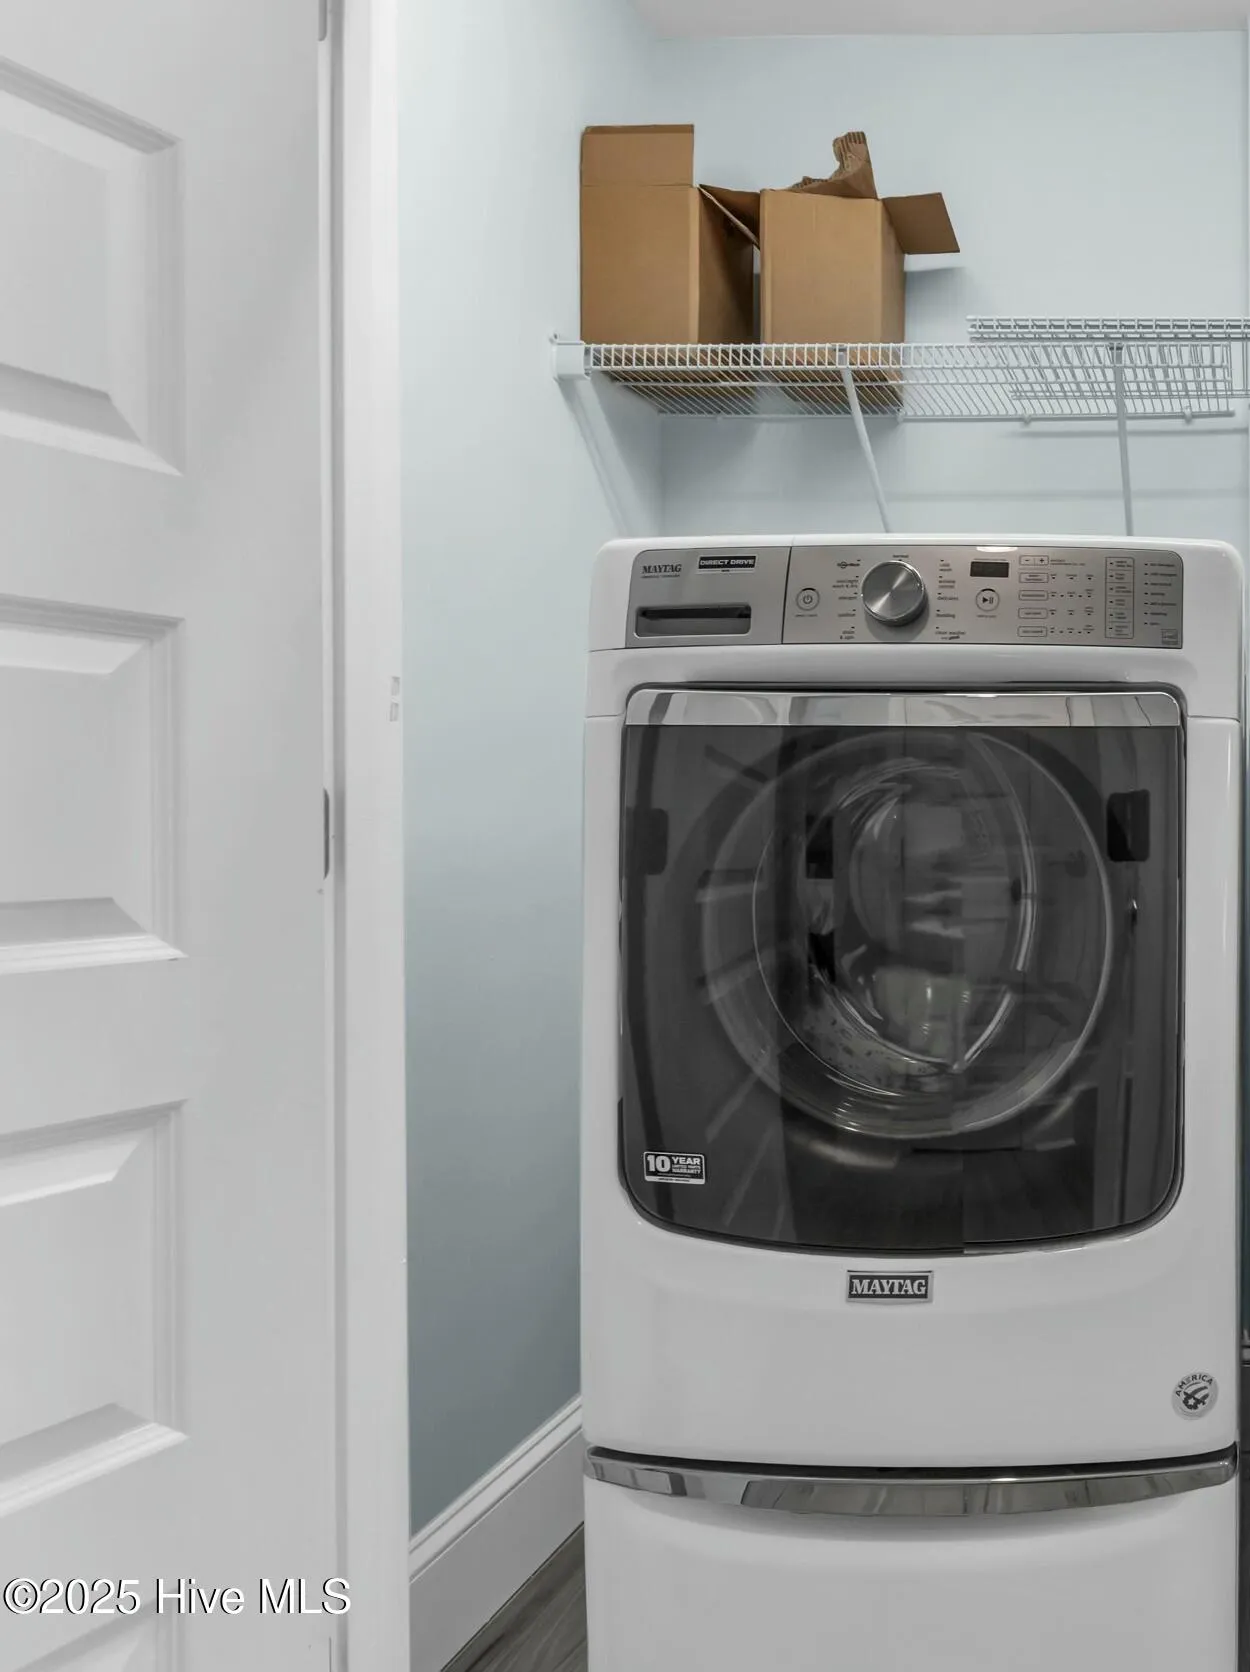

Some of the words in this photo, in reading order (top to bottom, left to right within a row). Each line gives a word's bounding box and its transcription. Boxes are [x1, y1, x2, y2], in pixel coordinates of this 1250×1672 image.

[642, 564, 682, 574] MAYTAG
[647, 1154, 671, 1173] 10
[672, 1156, 701, 1165] YEAR
[850, 1279, 927, 1295] MAYTAG
